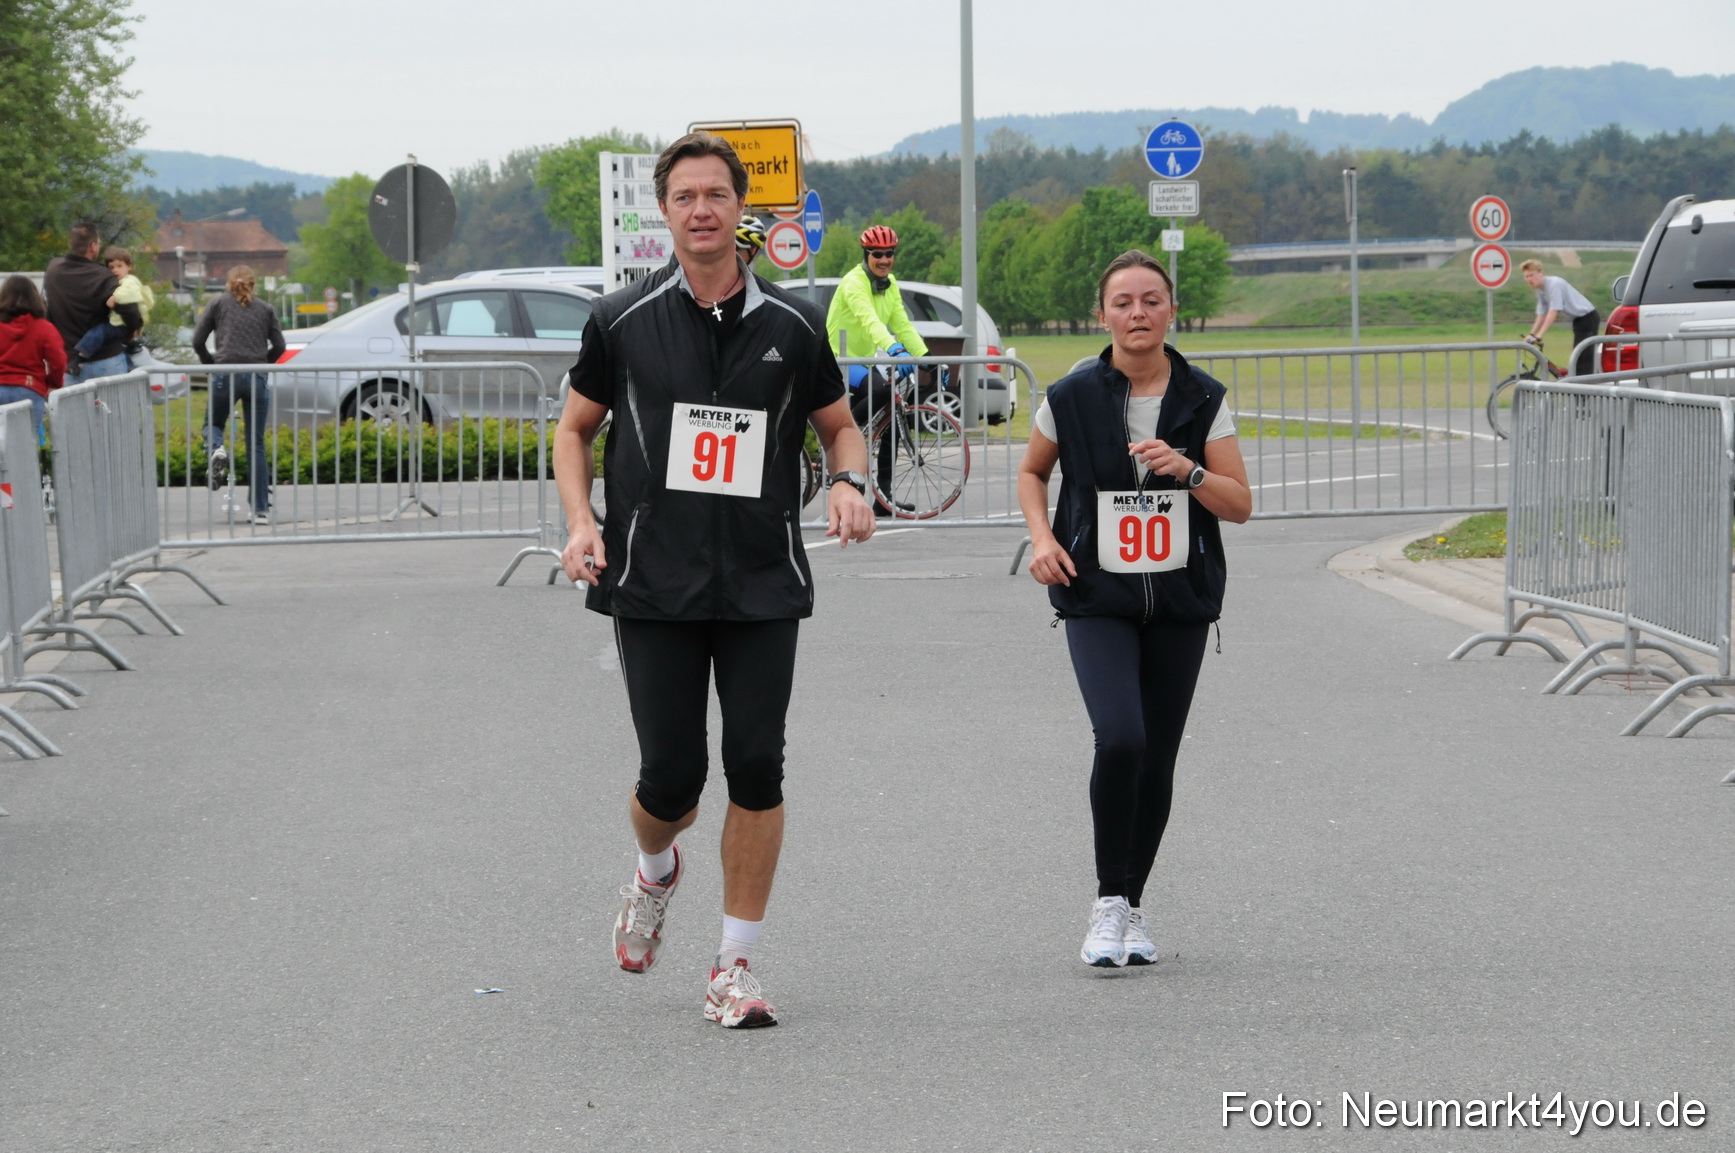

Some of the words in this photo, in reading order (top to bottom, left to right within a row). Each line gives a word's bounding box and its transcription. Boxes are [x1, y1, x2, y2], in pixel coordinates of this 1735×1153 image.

[732, 140, 761, 150] Nach
[742, 155, 789, 175] markt
[1158, 186, 1190, 194] Landwirt-
[1155, 195, 1193, 203] schaftlicher
[1155, 204, 1180, 212] Verkehr
[622, 212, 640, 233] SHB
[1480, 208, 1502, 229] 60
[762, 354, 783, 362] adidas
[689, 409, 732, 421] MEYER
[688, 419, 732, 430] WERBUNG
[692, 431, 737, 483] 91
[1119, 515, 1171, 563] 90
